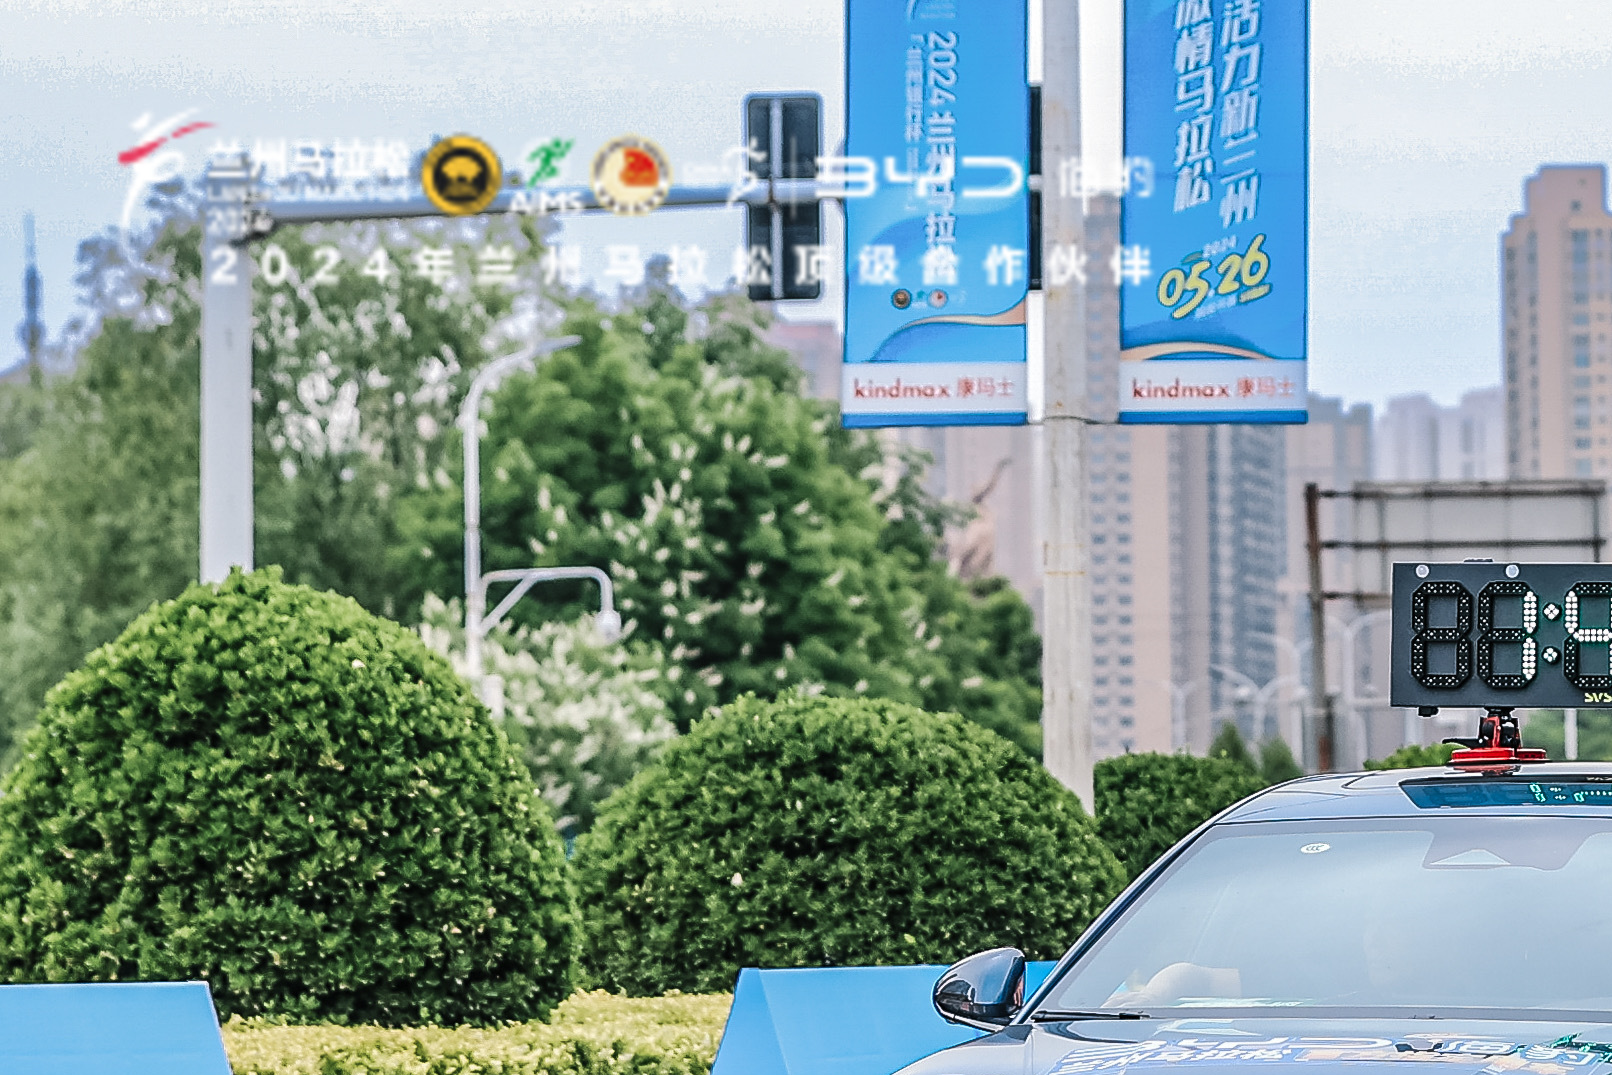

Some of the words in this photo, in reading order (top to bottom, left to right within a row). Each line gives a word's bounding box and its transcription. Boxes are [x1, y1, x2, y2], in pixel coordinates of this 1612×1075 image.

[854, 378, 950, 398] kindmax
[957, 376, 1013, 398] 康玛士
[1132, 377, 1230, 398] kindmax
[1237, 376, 1295, 398] 康玛士
